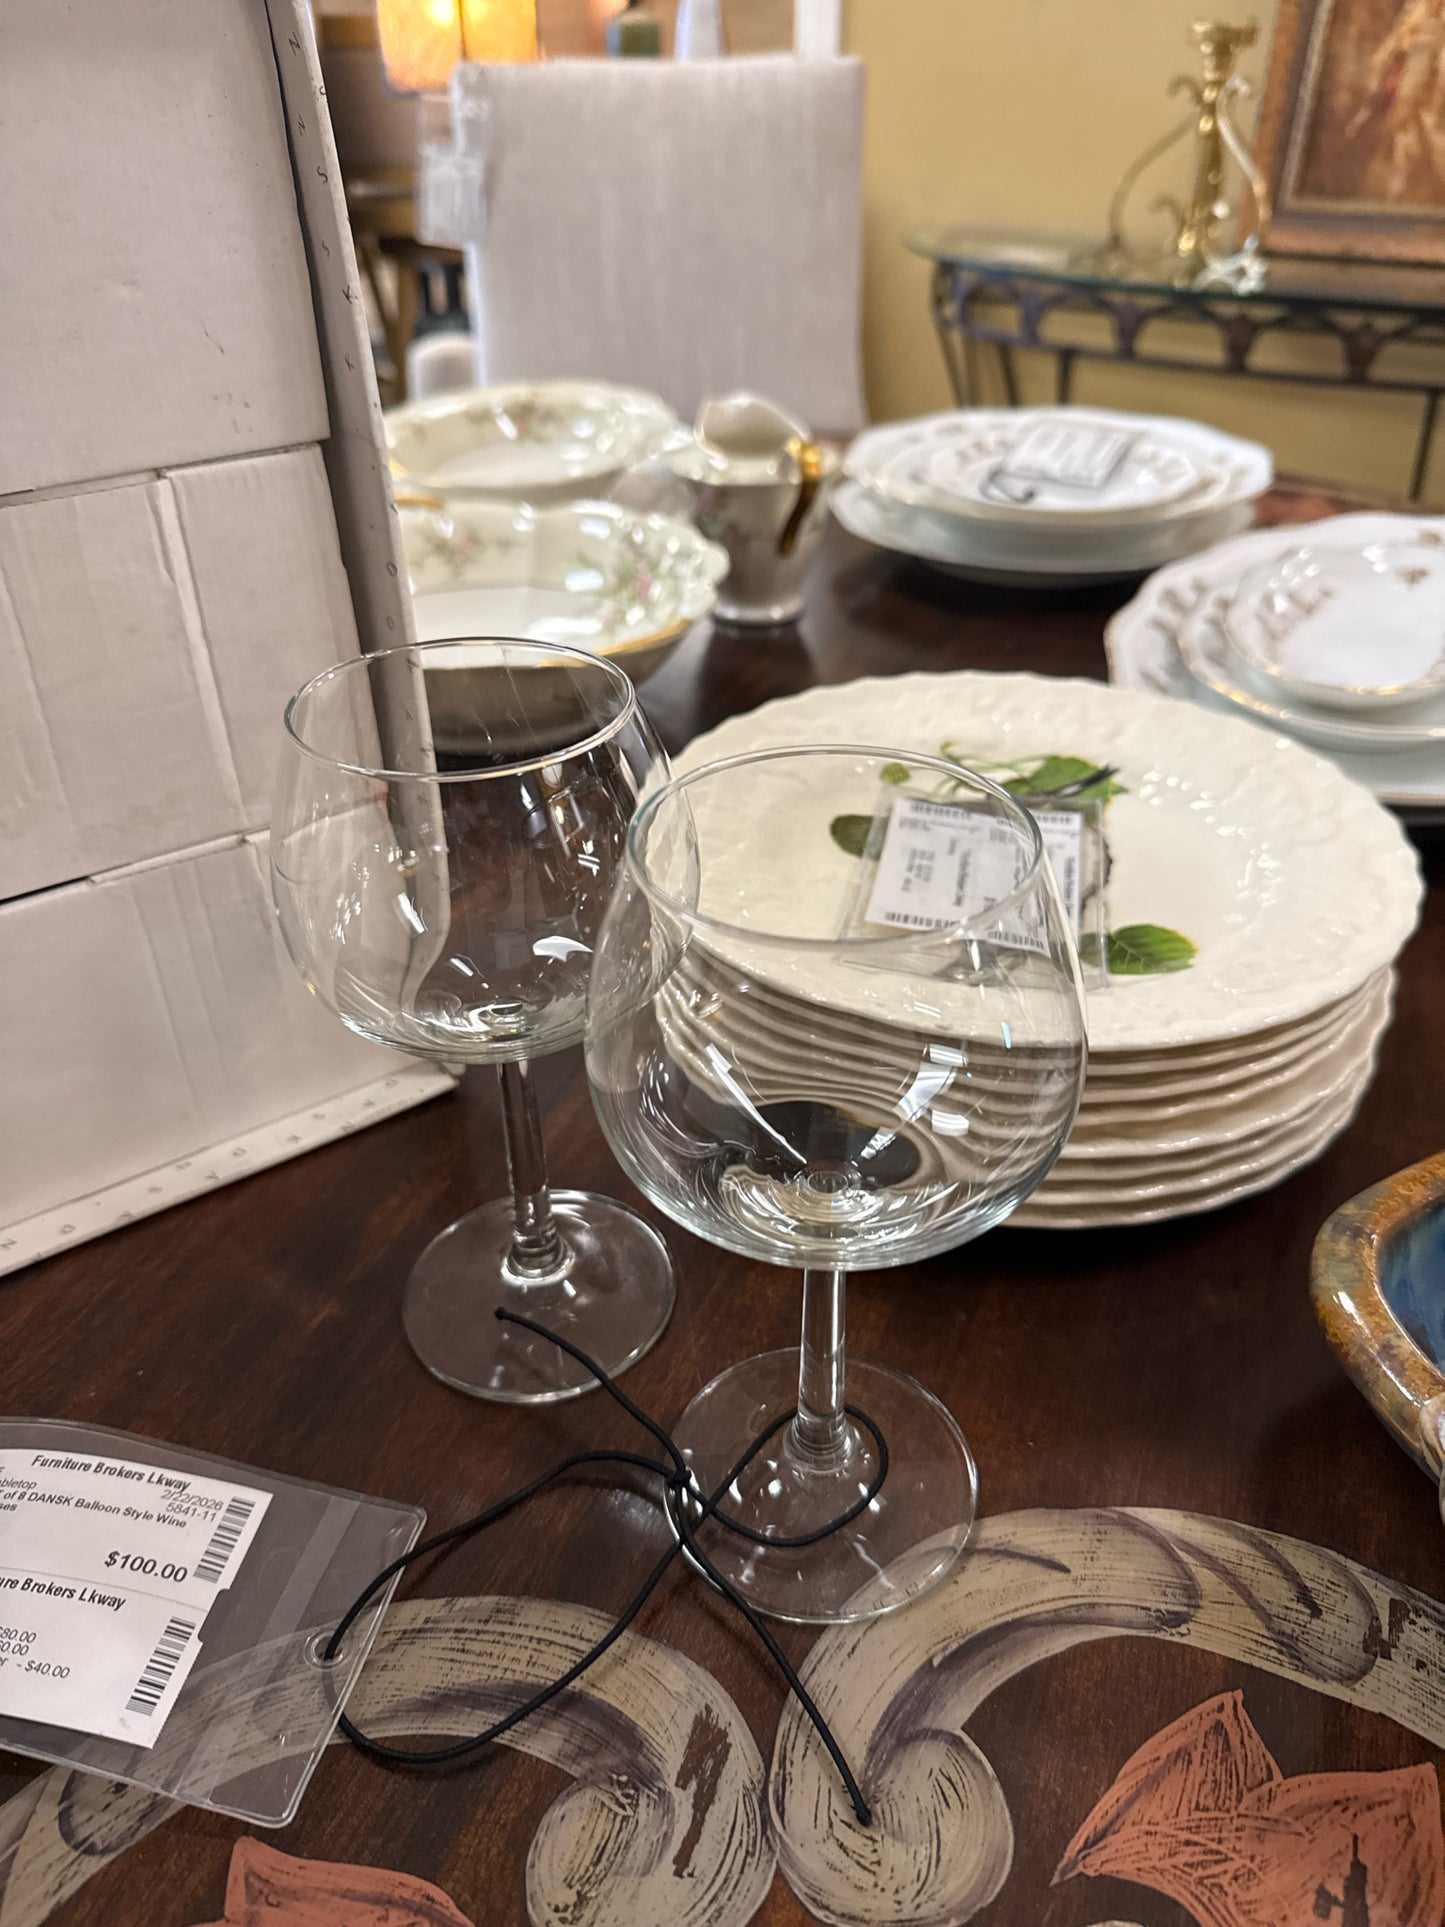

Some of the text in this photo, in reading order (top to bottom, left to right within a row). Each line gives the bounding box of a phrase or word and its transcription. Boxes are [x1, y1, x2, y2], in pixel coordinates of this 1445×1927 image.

[31, 1455, 191, 1493] Furniture Brokers Lkway
[3, 1490, 187, 1528] of 8 DANSK Balloon Style Wine
[160, 1489, 224, 1511] 2/22/2026
[166, 1502, 217, 1522] 5841-11
[104, 1550, 188, 1583] $100.00
[20, 1578, 77, 1599] Brokers
[78, 1587, 126, 1611] Lkway
[24, 1660, 70, 1679] $40.00
